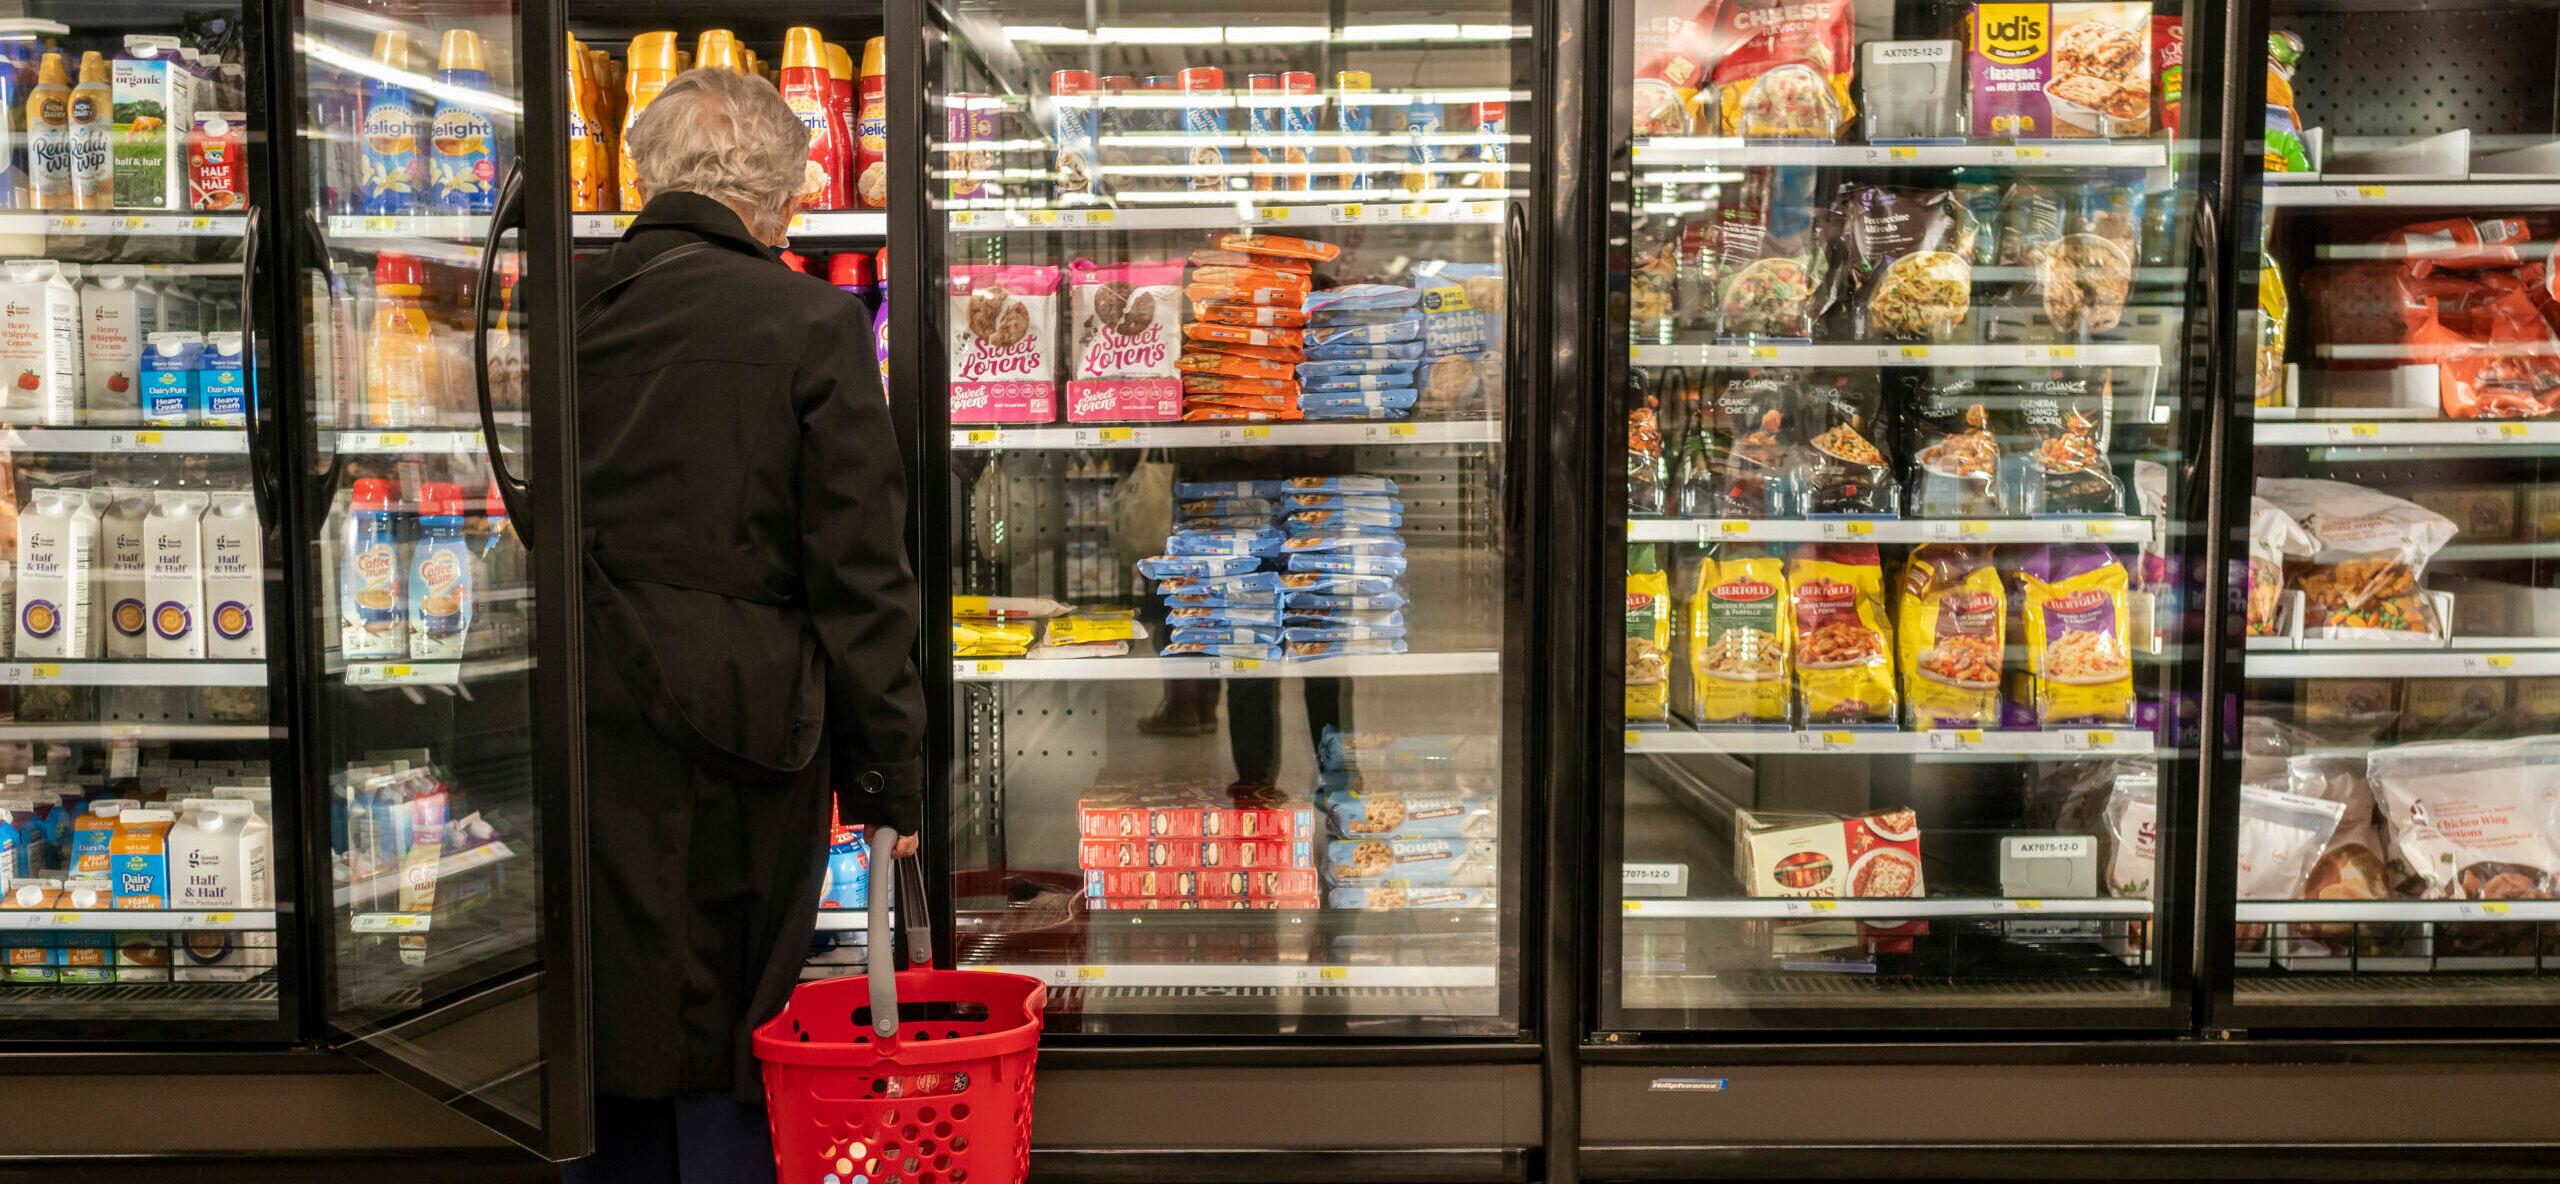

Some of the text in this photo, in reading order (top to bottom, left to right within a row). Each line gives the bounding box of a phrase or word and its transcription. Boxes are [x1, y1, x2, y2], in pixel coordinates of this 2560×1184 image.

[1733, 3, 1832, 29] CHEESE
[1987, 16, 2041, 42] udis
[116, 75, 161, 88] organic
[115, 157, 133, 167] half
[143, 157, 162, 167] half
[201, 166, 229, 176] HALF
[202, 180, 231, 190] HALF
[8, 322, 30, 333] Heavy
[96, 326, 119, 336] Heavy
[1, 331, 39, 342] Whipping
[91, 334, 129, 344] Whipping
[1102, 322, 1163, 352] Sweet
[7, 339, 32, 347] Cream
[975, 334, 1038, 364] Sweet
[1085, 342, 1166, 376] Loren's
[959, 352, 1041, 382] Loren's
[955, 384, 986, 400] Sweet
[1083, 387, 1115, 403] Sweet
[156, 397, 183, 405] Heavy
[213, 396, 240, 404] Heavy
[156, 403, 183, 411] Cream
[1074, 398, 1117, 416] Loren's
[31, 553, 54, 562] Half
[118, 553, 141, 562] Half
[160, 555, 182, 563] Half
[218, 555, 241, 563] Half
[26, 563, 60, 572] & Half
[155, 564, 189, 573] & Half
[214, 564, 248, 573] & Half
[1717, 585, 1769, 596] BERTOLLI
[2436, 816, 2509, 830] Chicken Wing
[2020, 842, 2079, 852] AX7075-12-D
[122, 873, 153, 886] Dairy
[190, 874, 219, 885] Half
[1623, 870, 1670, 879] 7075-12-D
[185, 887, 227, 898] & Half
[128, 896, 150, 905] Half
